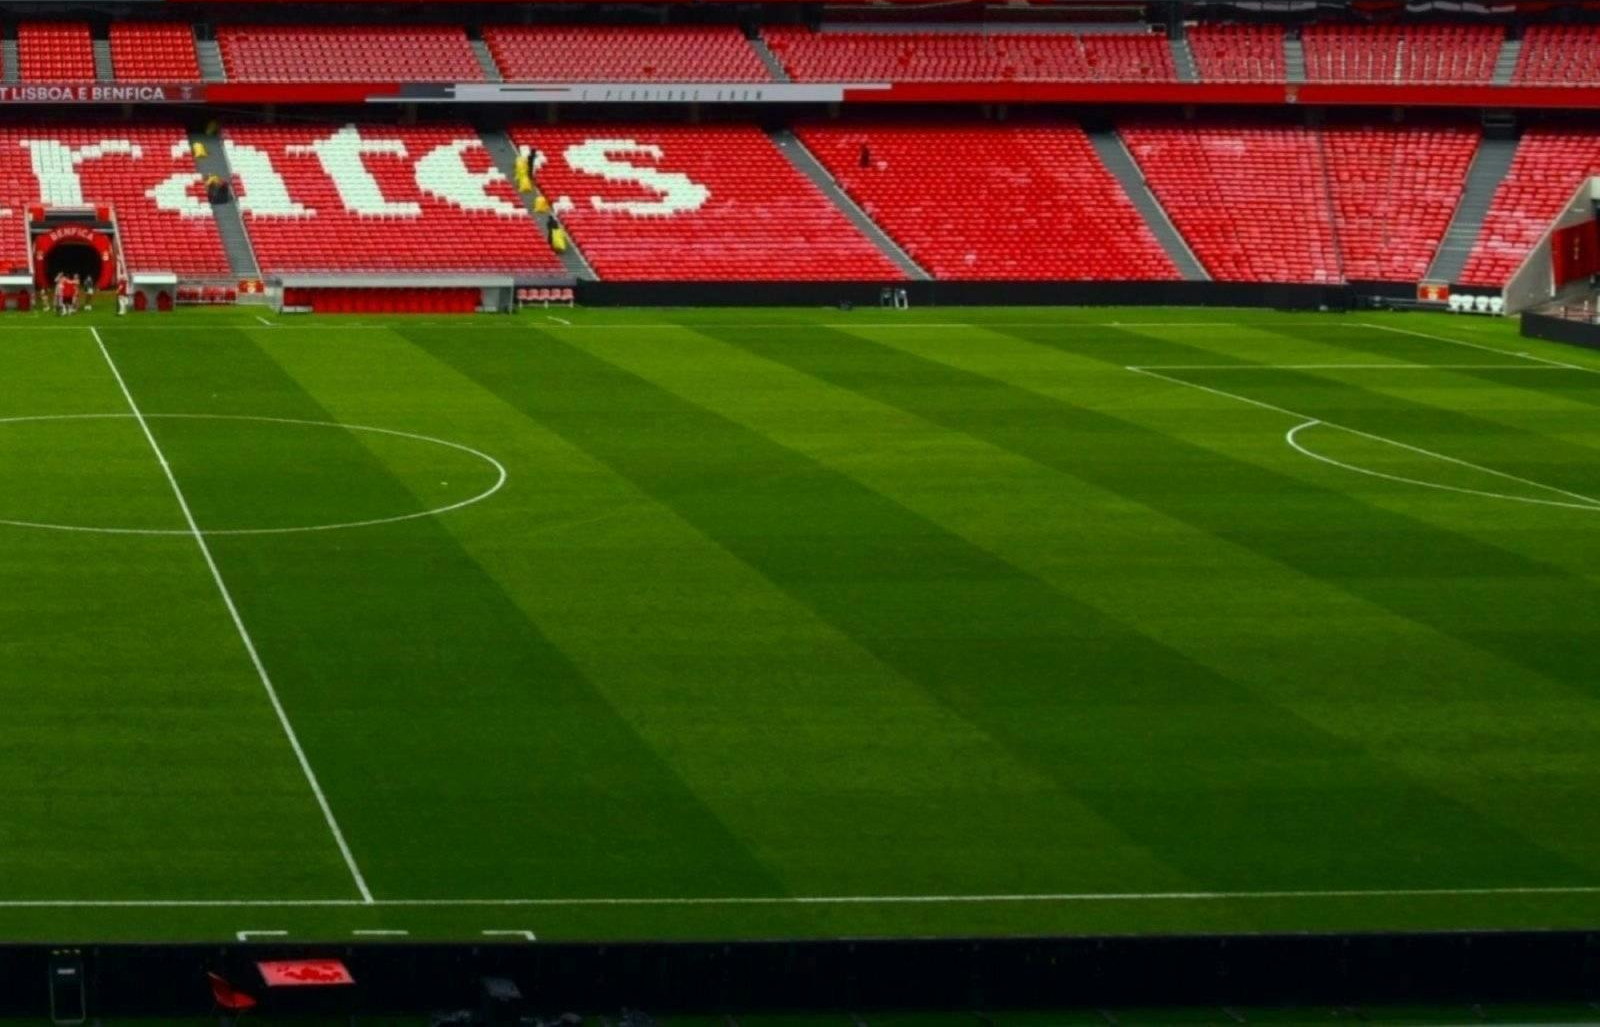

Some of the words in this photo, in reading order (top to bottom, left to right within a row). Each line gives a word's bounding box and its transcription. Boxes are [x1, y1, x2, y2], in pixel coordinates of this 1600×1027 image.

[12, 86, 74, 101] LISBOA
[79, 86, 88, 101] E
[92, 86, 165, 101] BENFICA
